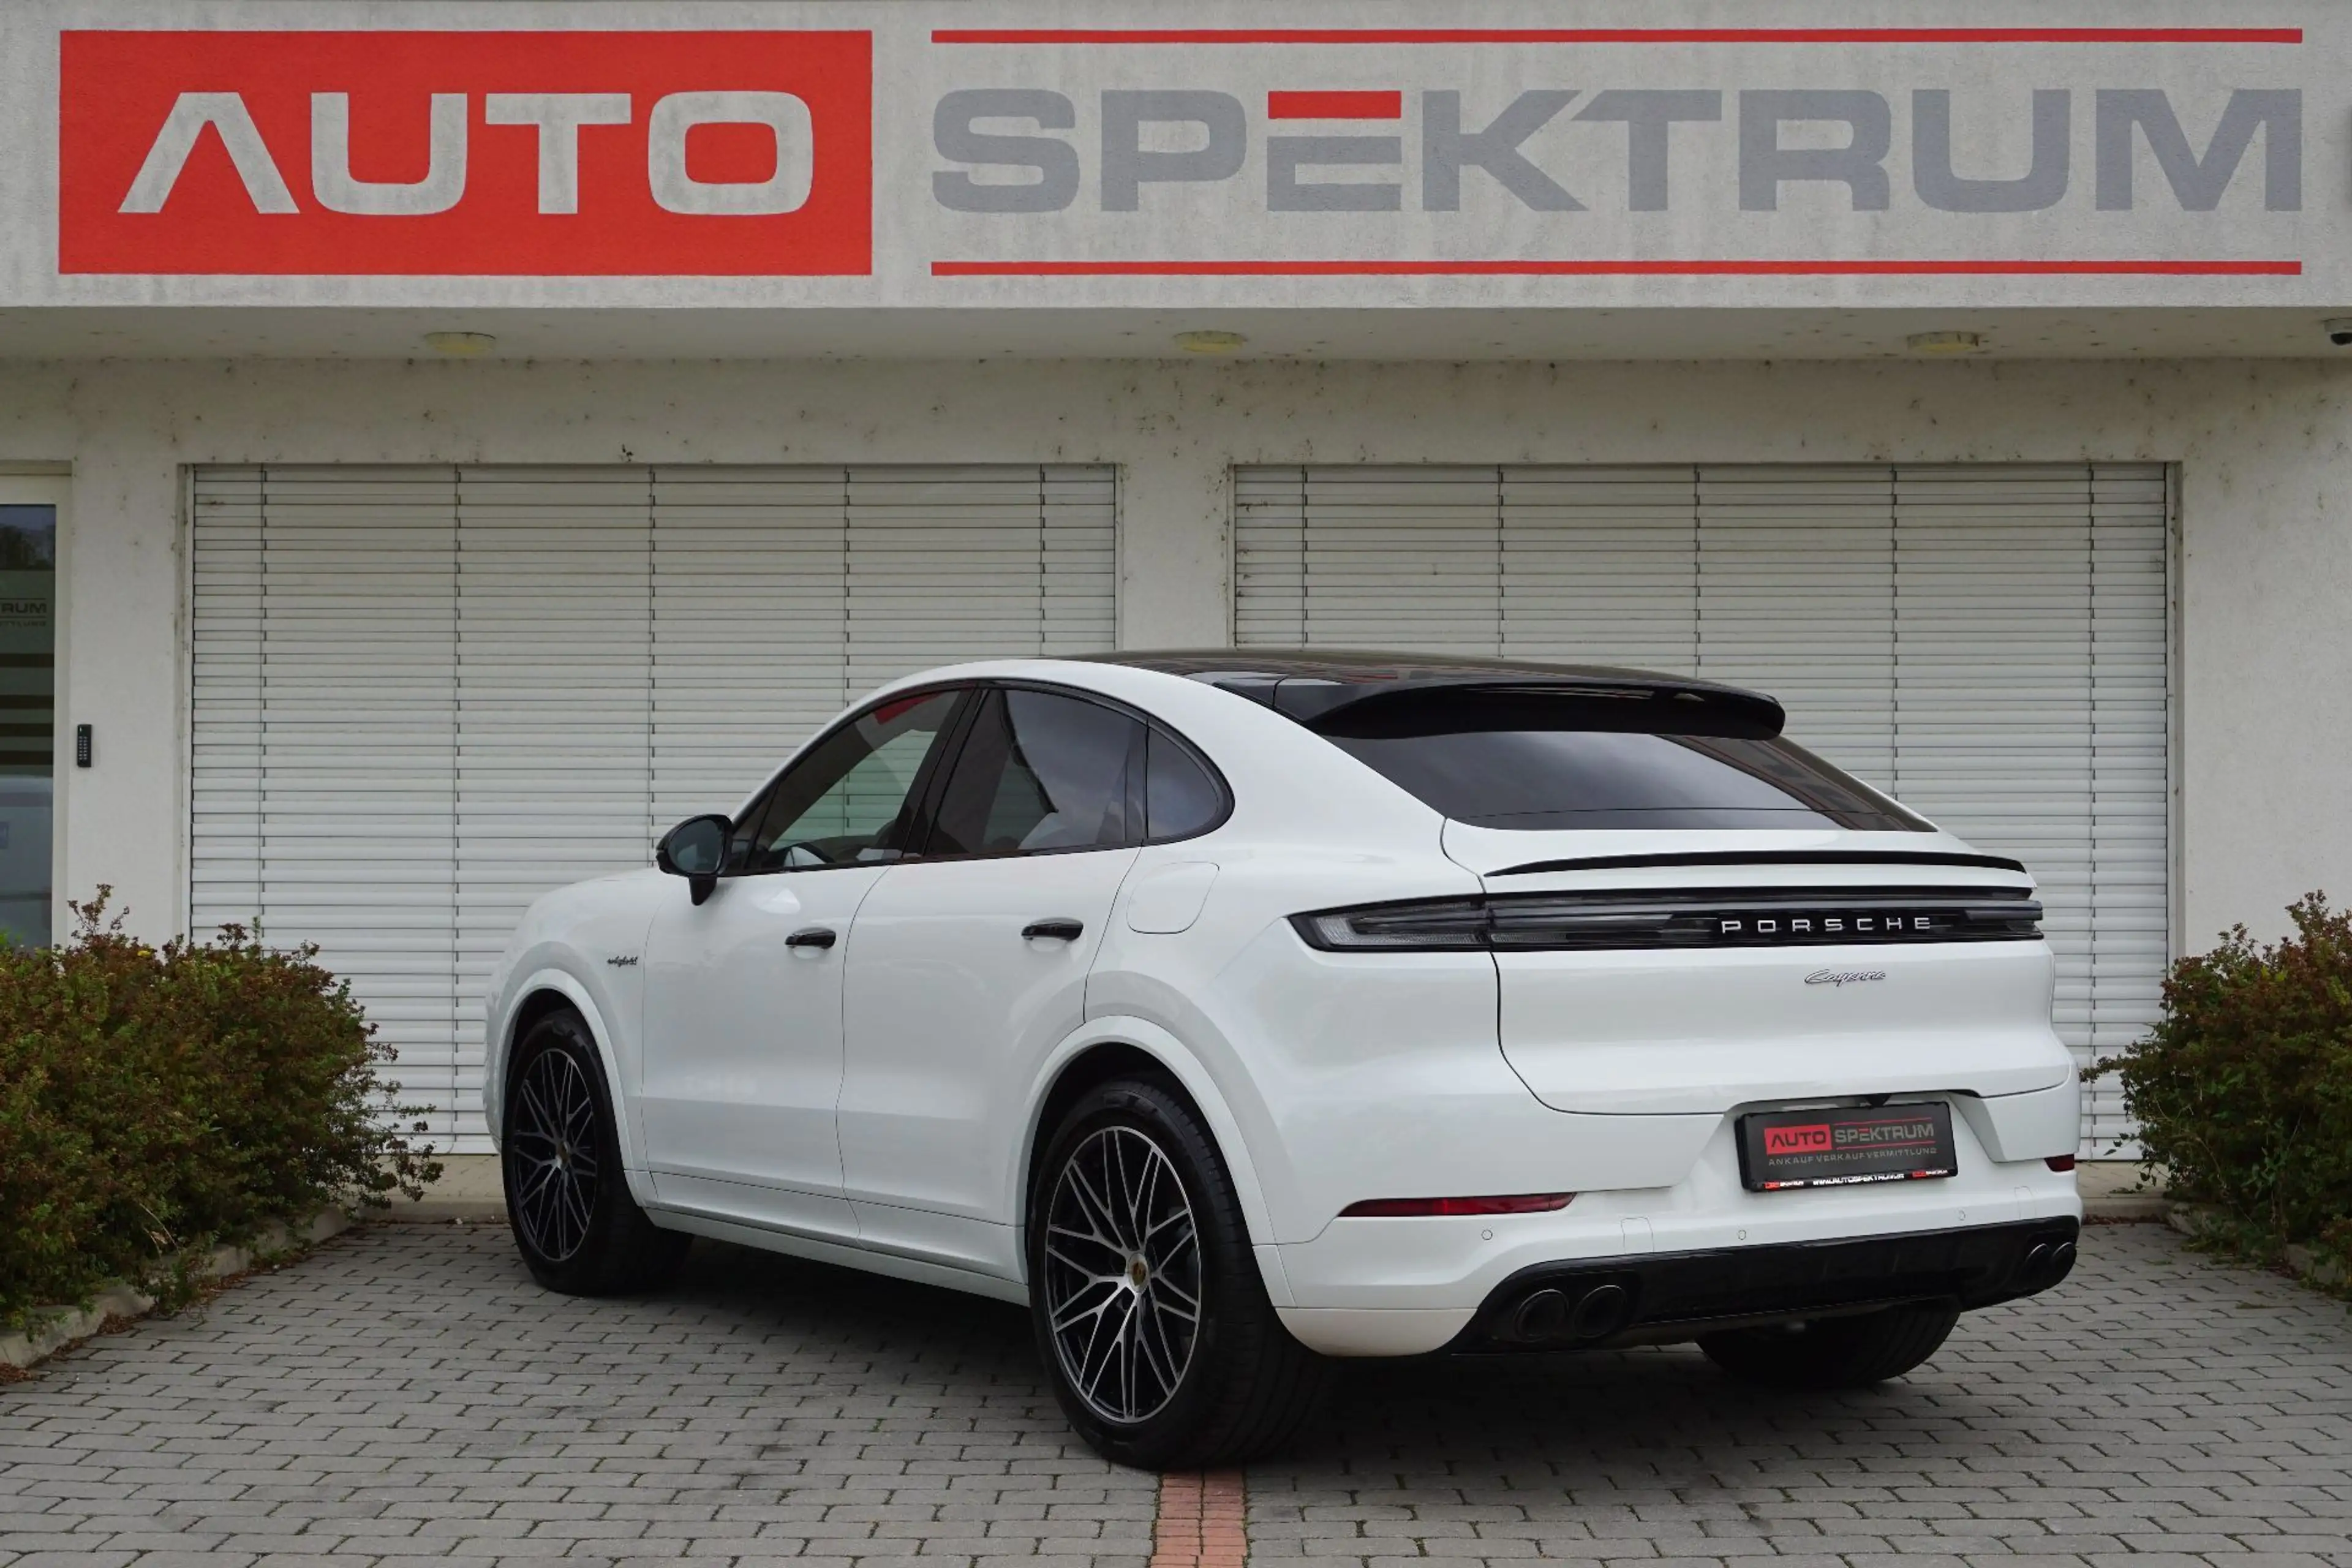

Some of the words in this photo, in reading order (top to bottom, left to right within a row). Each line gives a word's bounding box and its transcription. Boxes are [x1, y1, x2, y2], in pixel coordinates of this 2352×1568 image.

[118, 90, 814, 216] AUTO
[932, 88, 2302, 214] SPEKTRUM
[0, 602, 47, 614] RUM
[1721, 916, 1931, 934] PORSCHE
[1804, 968, 1886, 987] Cayenne
[1771, 1130, 1826, 1147] AUTO
[1834, 1123, 1934, 1143] SPEKTRUM
[1768, 1156, 1814, 1166] ANKAUF
[1816, 1152, 1866, 1162] VERKAUF
